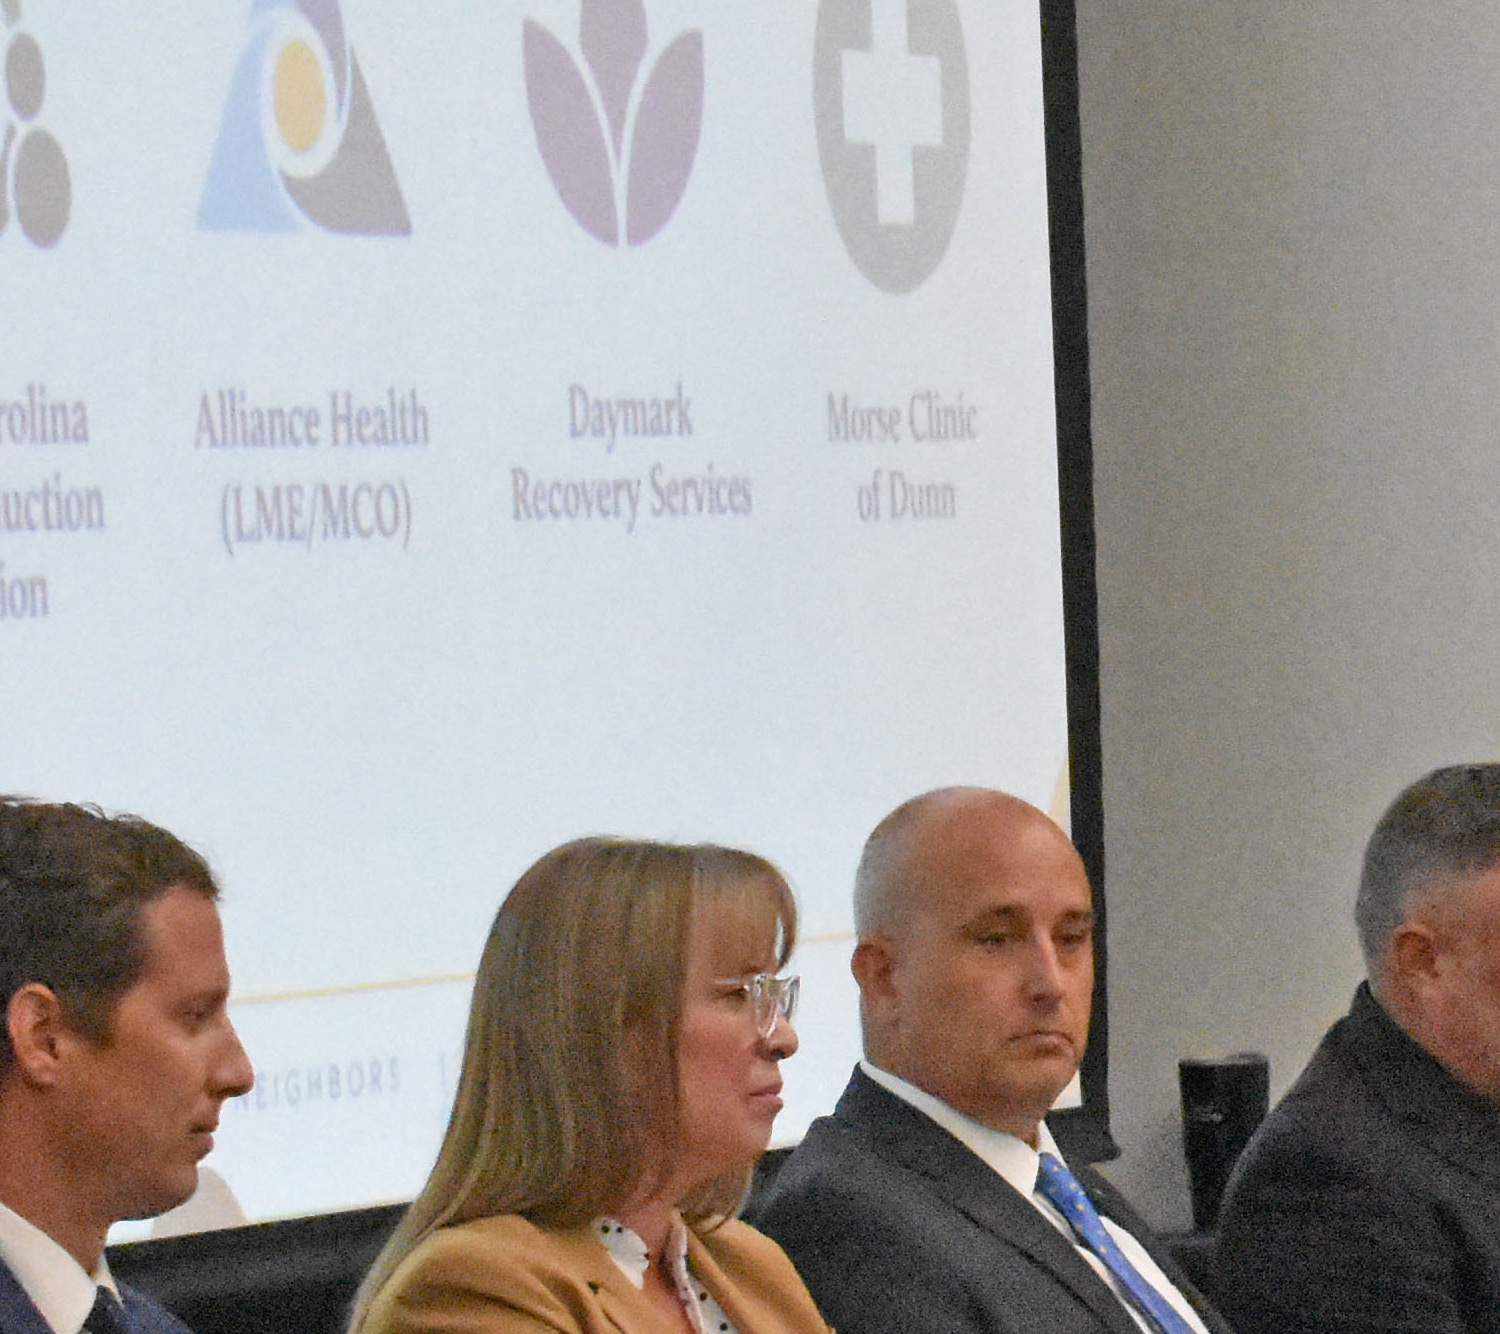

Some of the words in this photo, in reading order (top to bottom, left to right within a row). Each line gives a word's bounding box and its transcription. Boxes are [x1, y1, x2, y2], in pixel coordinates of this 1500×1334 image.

[194, 387, 321, 449] Alliance
[330, 387, 430, 448] Health
[568, 380, 693, 455] Daymark
[827, 391, 902, 444] Morse
[908, 389, 978, 443] Clinic
[221, 478, 412, 556] (LME/MCO)
[511, 466, 642, 535] Recovery
[650, 461, 753, 517] Services
[857, 467, 884, 523] of
[889, 469, 957, 519] Dunn
